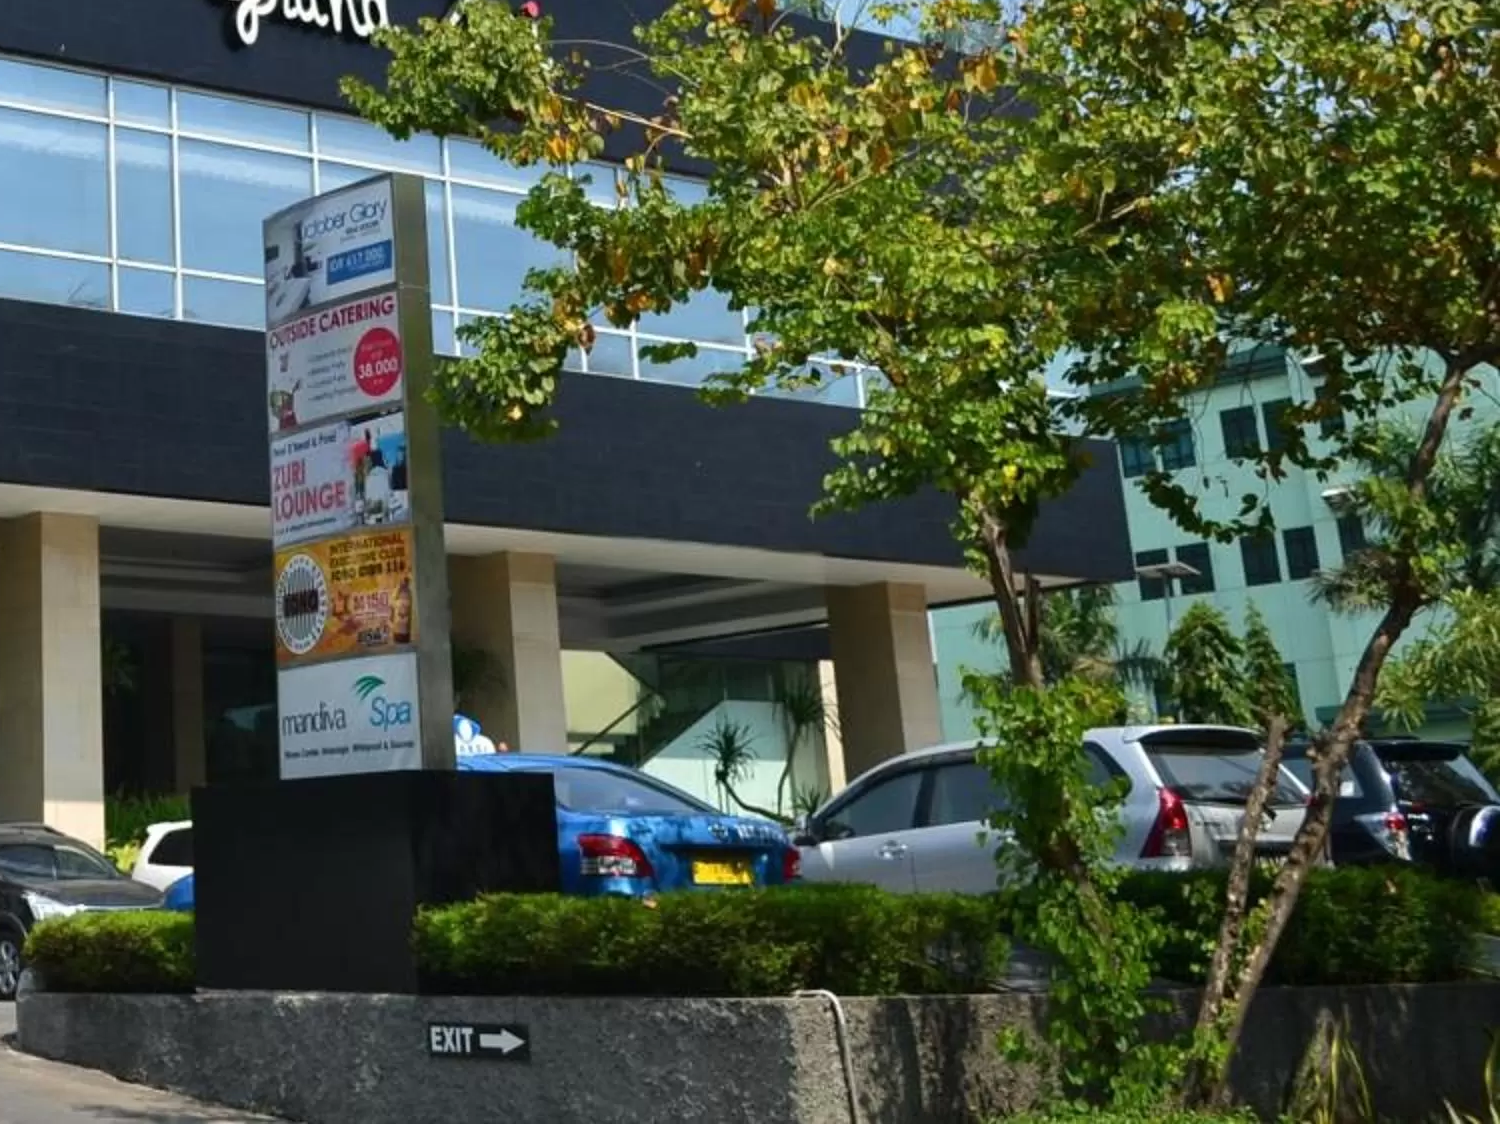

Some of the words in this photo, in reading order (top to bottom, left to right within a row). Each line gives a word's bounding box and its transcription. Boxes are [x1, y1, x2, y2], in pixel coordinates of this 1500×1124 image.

[269, 319, 316, 350] OUTSIDE
[319, 295, 394, 333] CATERING
[274, 458, 305, 492] ZURI
[275, 480, 347, 522] LOUNGE
[369, 696, 412, 732] Spa
[430, 1025, 474, 1053] EXIT
